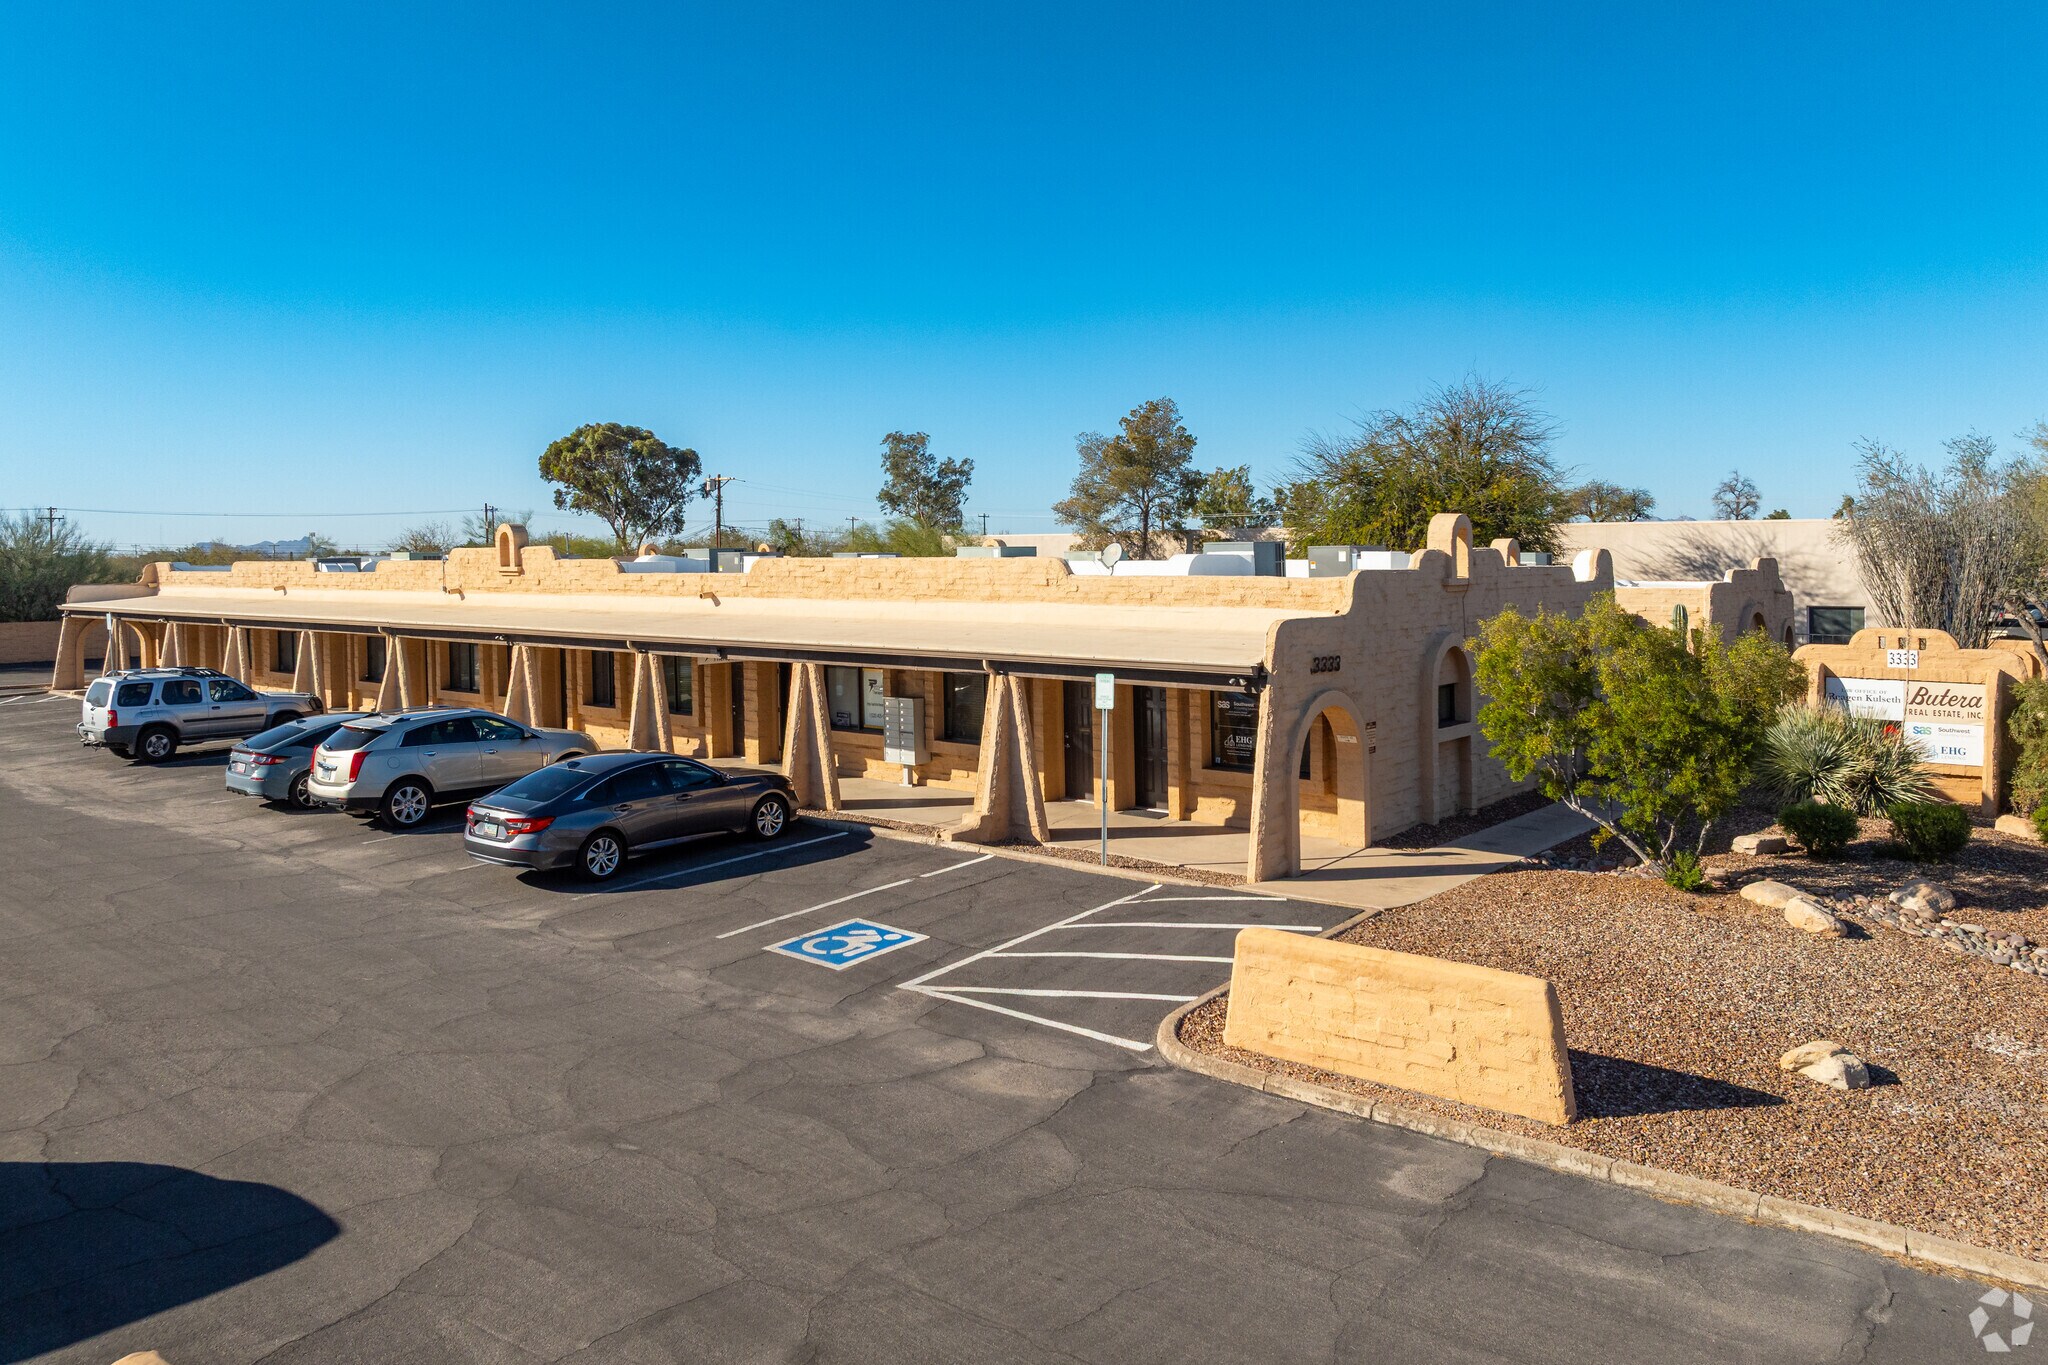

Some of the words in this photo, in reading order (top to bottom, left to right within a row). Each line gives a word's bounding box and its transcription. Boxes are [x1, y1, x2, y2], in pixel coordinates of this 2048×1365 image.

[1311, 655, 1341, 673] 3333
[1889, 652, 1916, 666] 3333
[1865, 694, 1901, 704] Kulseth
[1909, 686, 1983, 709] Butera
[1908, 708, 1929, 717] REAL
[1932, 710, 1964, 720] ESTATE,
[1967, 711, 1984, 720] INC.
[1235, 735, 1253, 744] EHG
[1941, 746, 1967, 756] EHG
